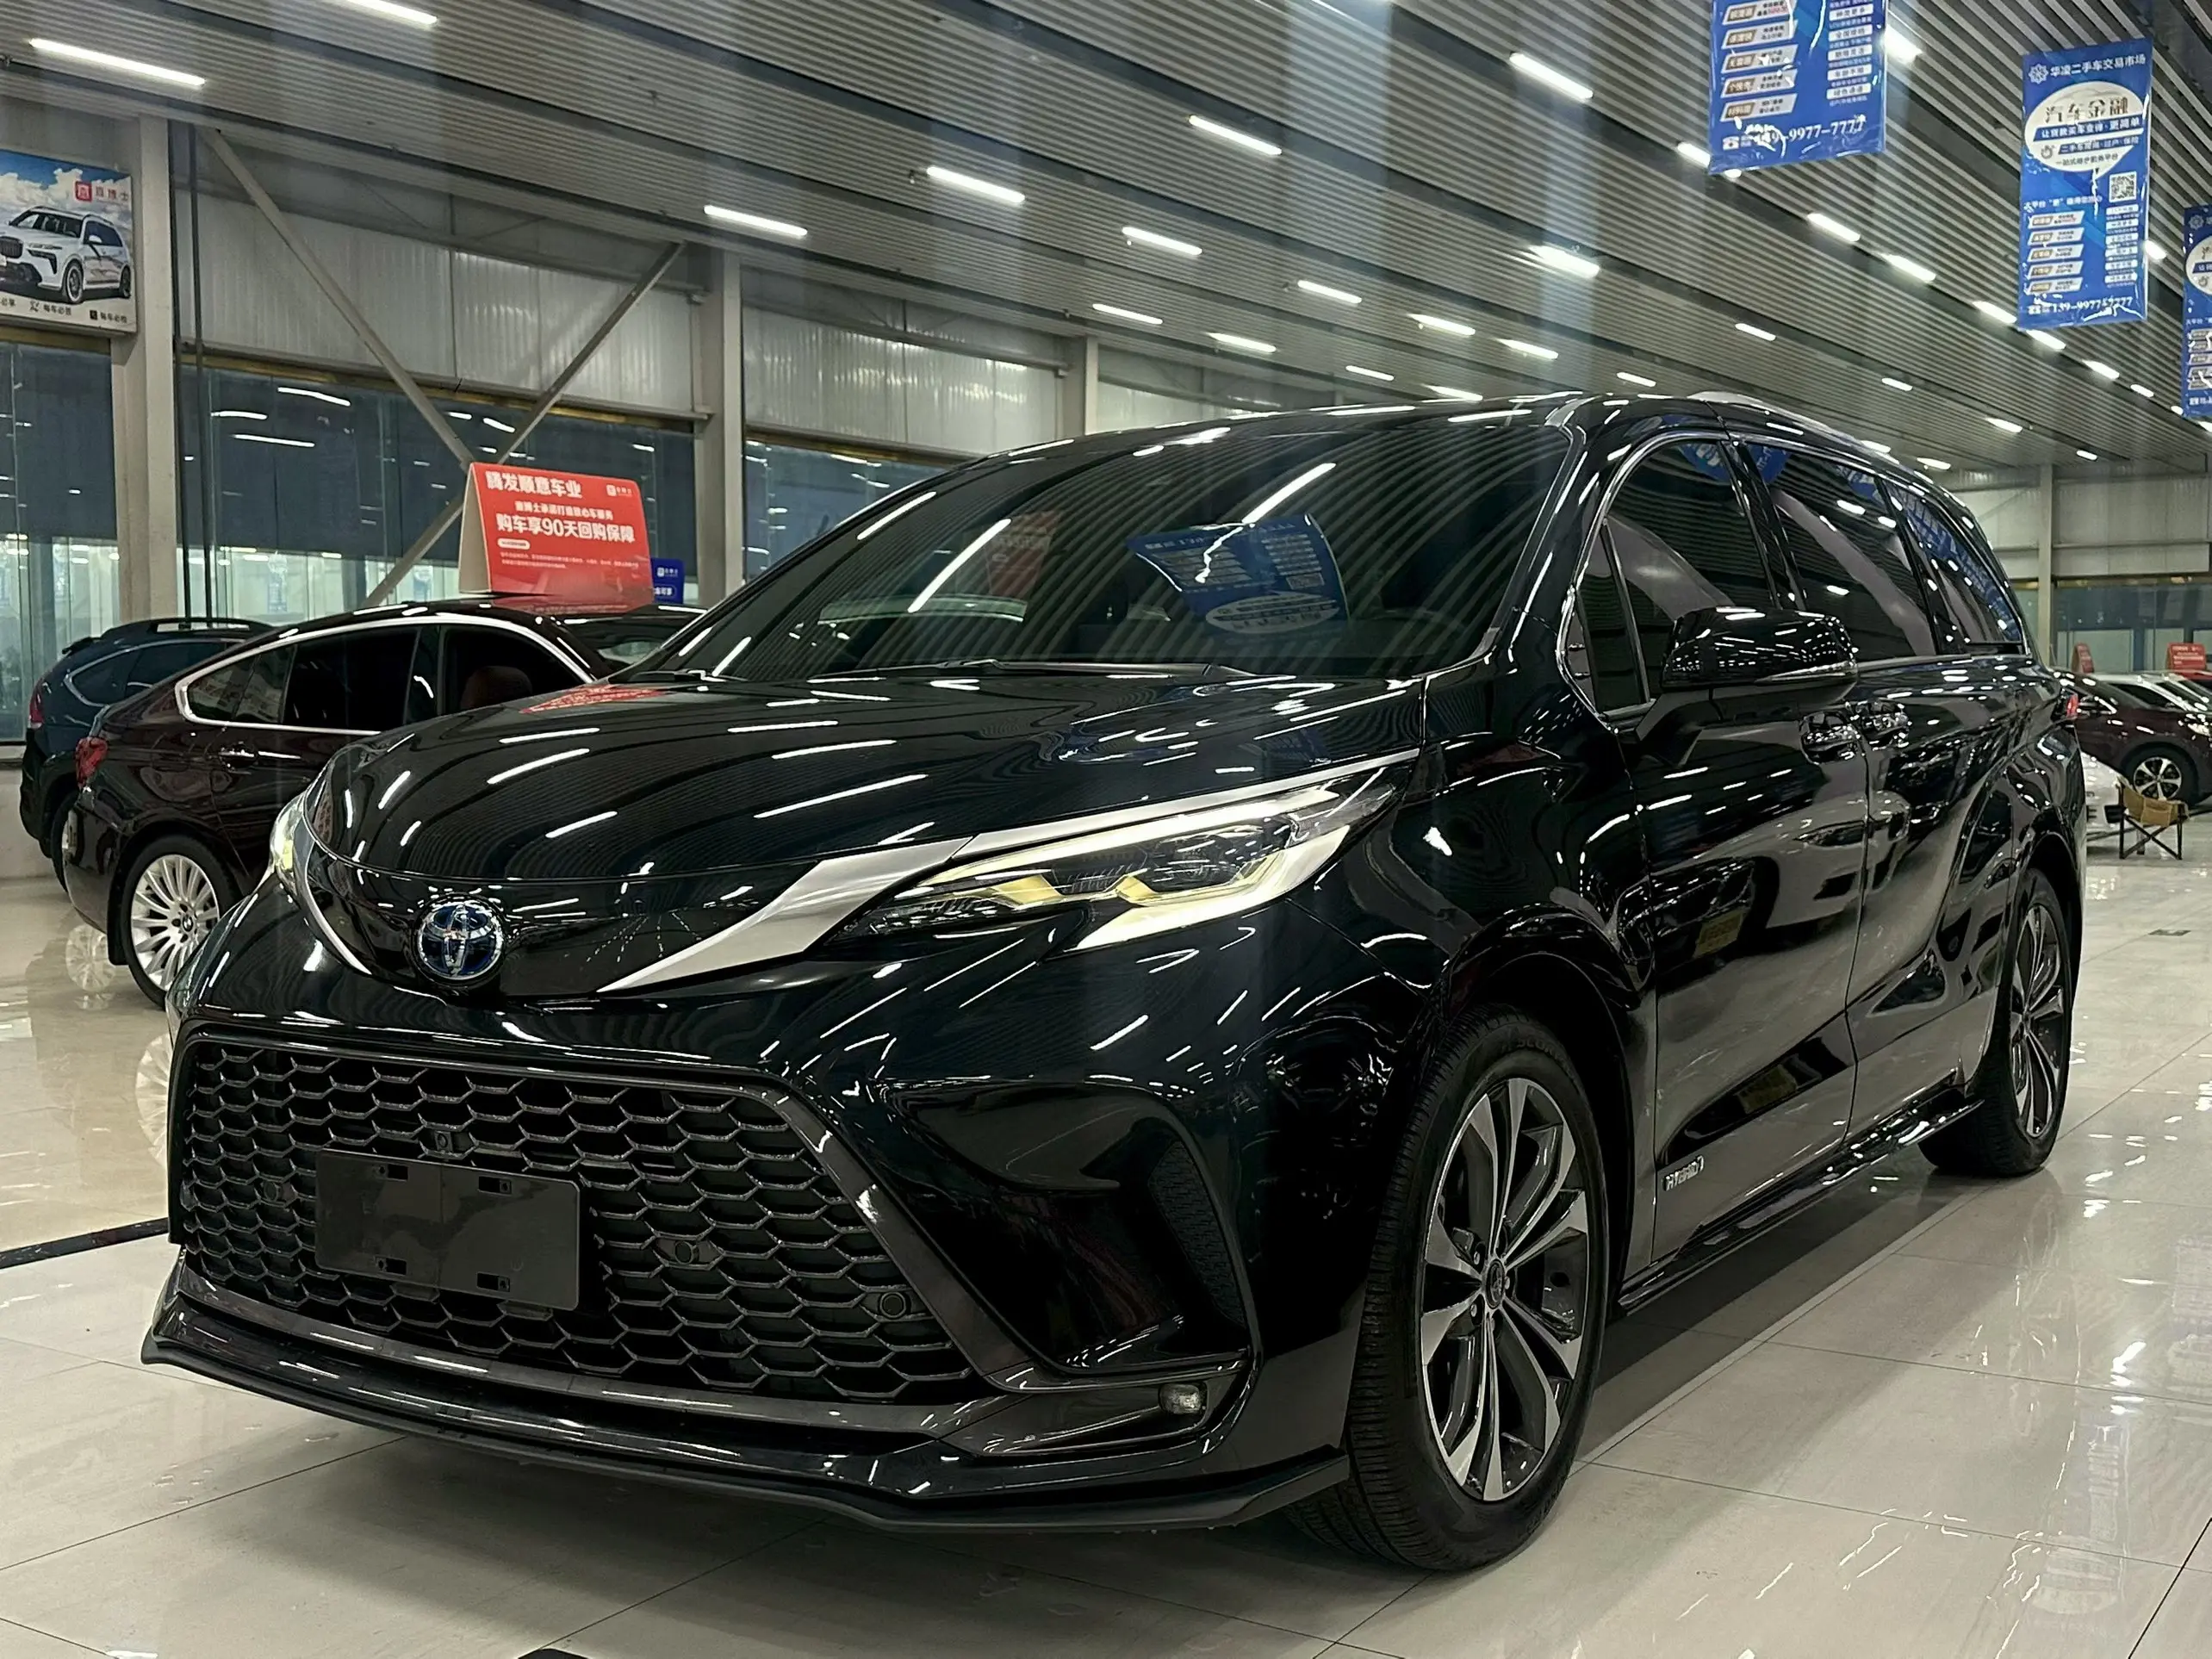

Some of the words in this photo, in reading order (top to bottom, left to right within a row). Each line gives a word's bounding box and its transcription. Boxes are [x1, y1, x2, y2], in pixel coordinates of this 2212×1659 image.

[2044, 96, 2128, 123] 汽车金融
[496, 513, 636, 544] 购车享90天回购保障
